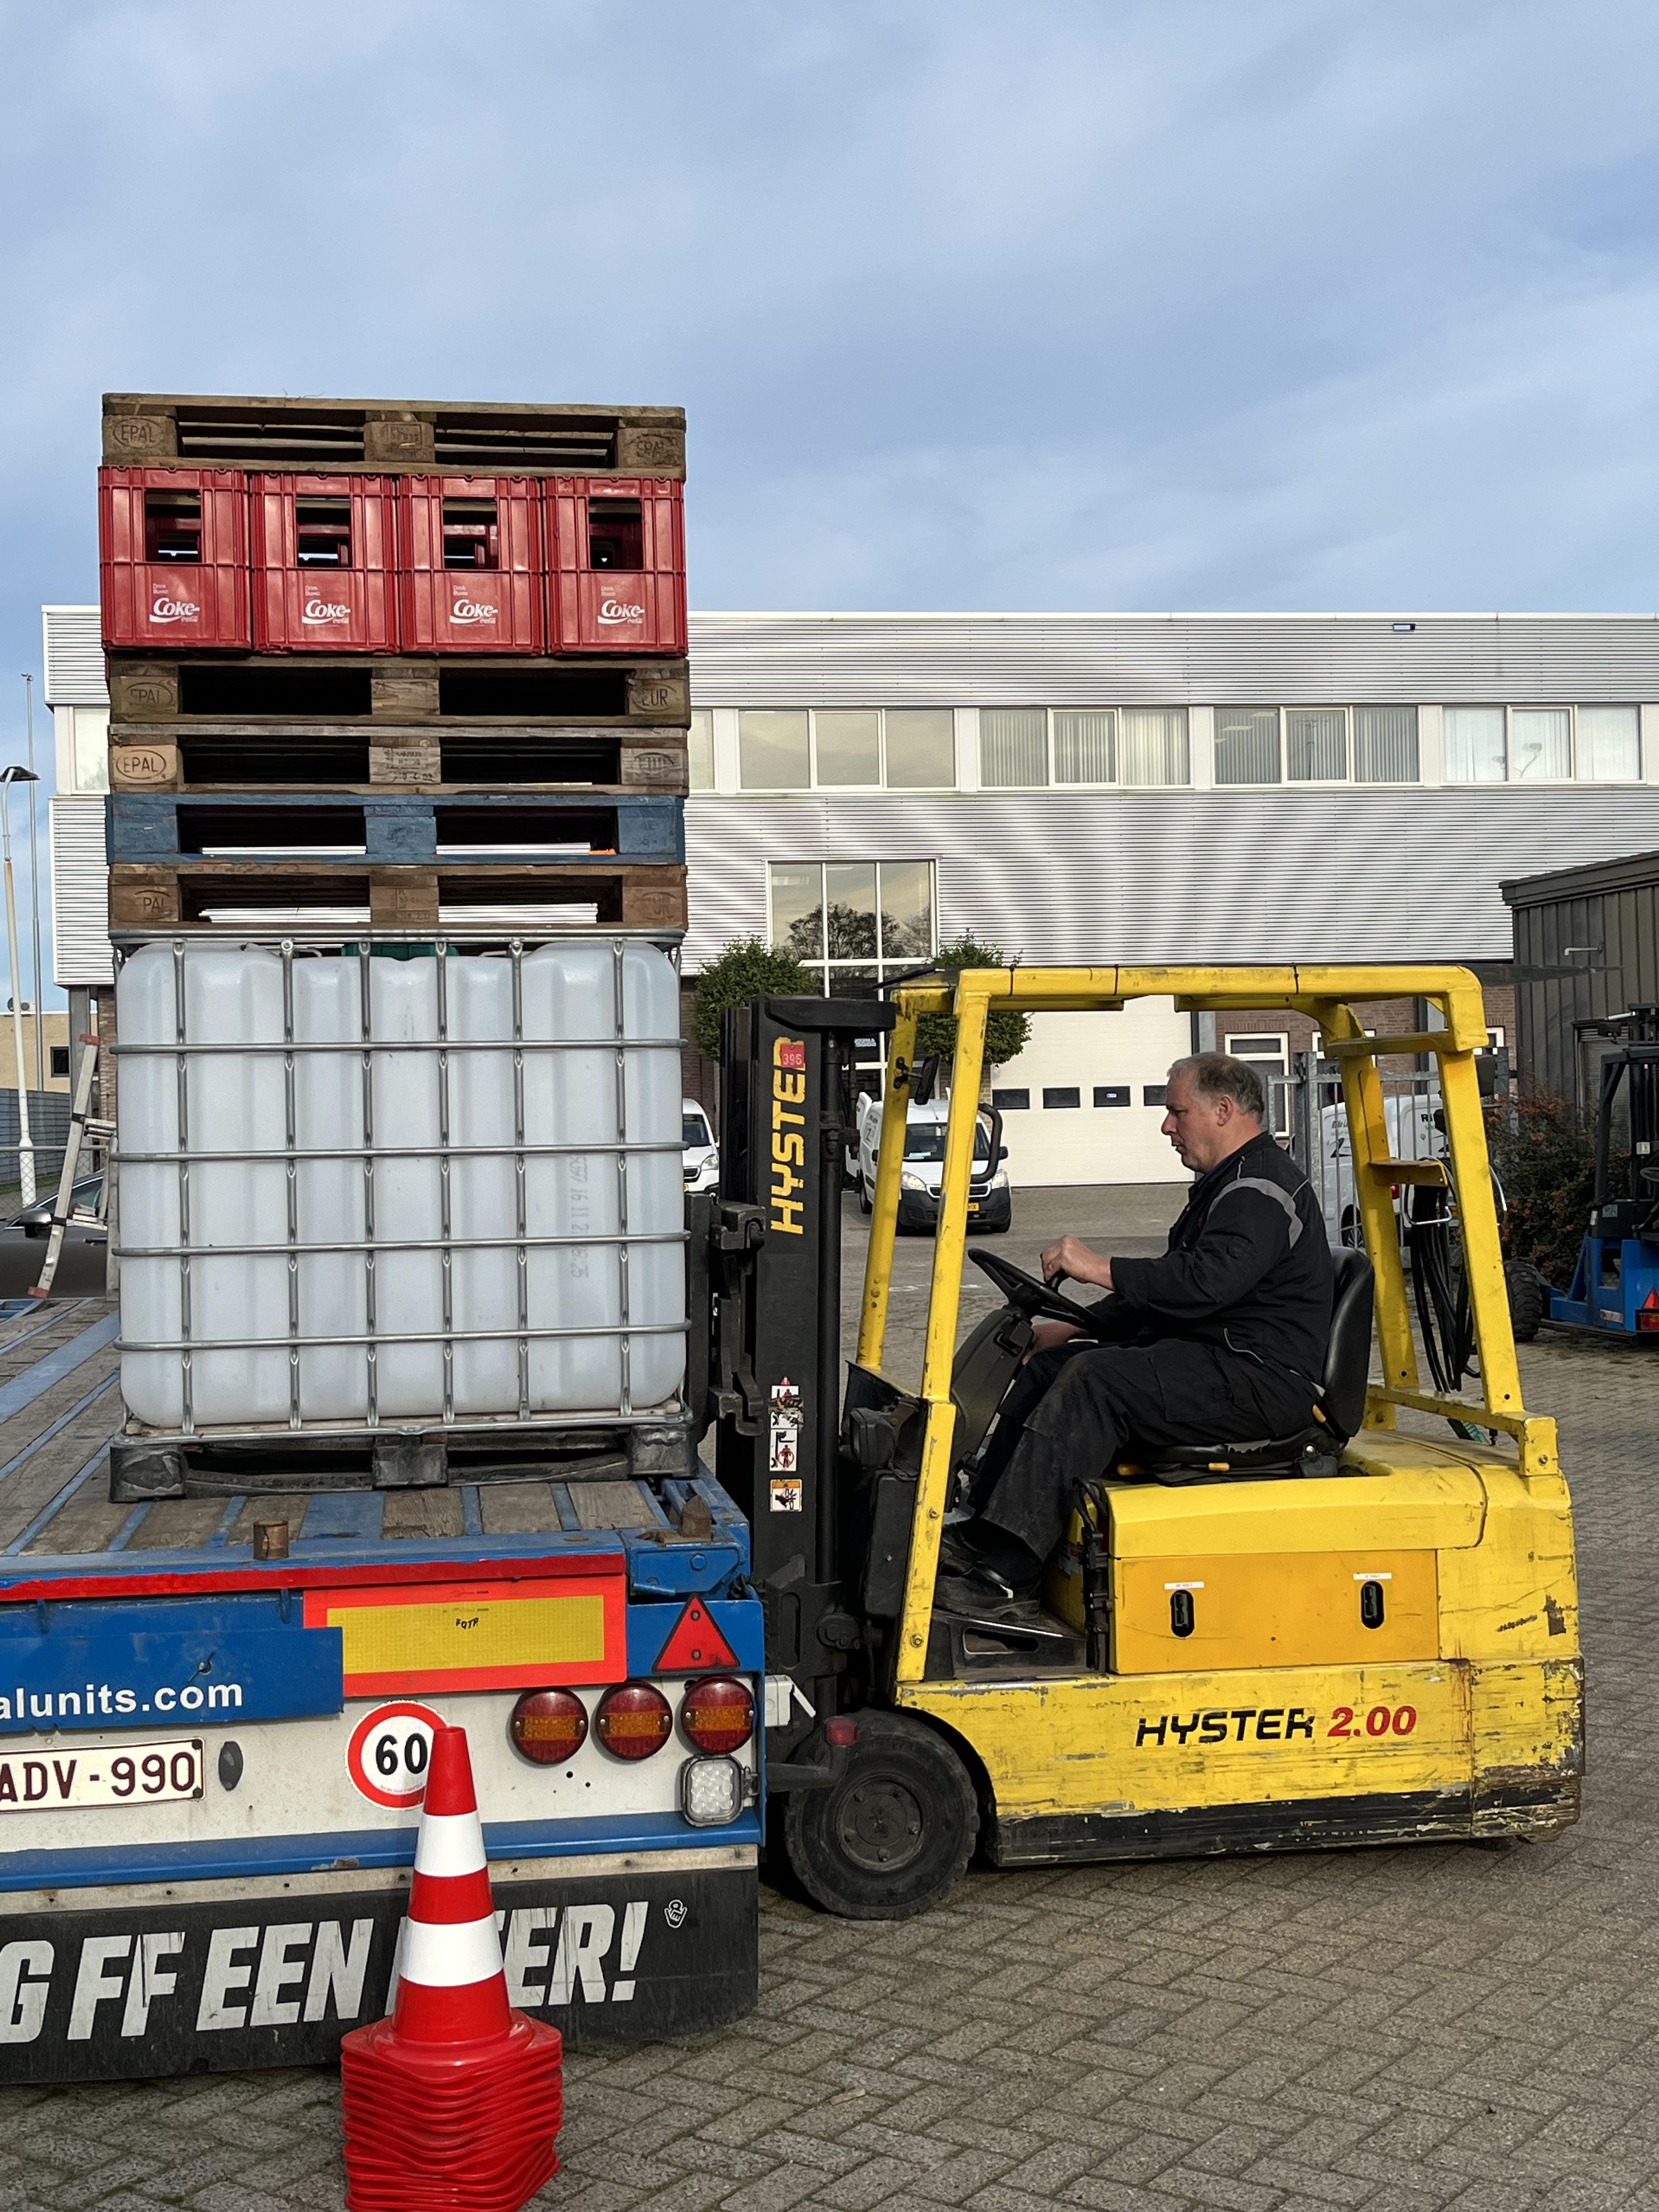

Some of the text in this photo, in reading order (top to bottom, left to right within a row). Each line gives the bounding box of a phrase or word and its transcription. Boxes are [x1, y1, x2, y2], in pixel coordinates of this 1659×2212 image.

[120, 424, 154, 443] EPAL
[123, 755, 158, 774] EPAL
[1136, 1705, 1418, 1747] HYSTER 2.00
[376, 1733, 428, 1775] 60
[66, 1931, 186, 2041] FF
[195, 1917, 375, 2032] EEN
